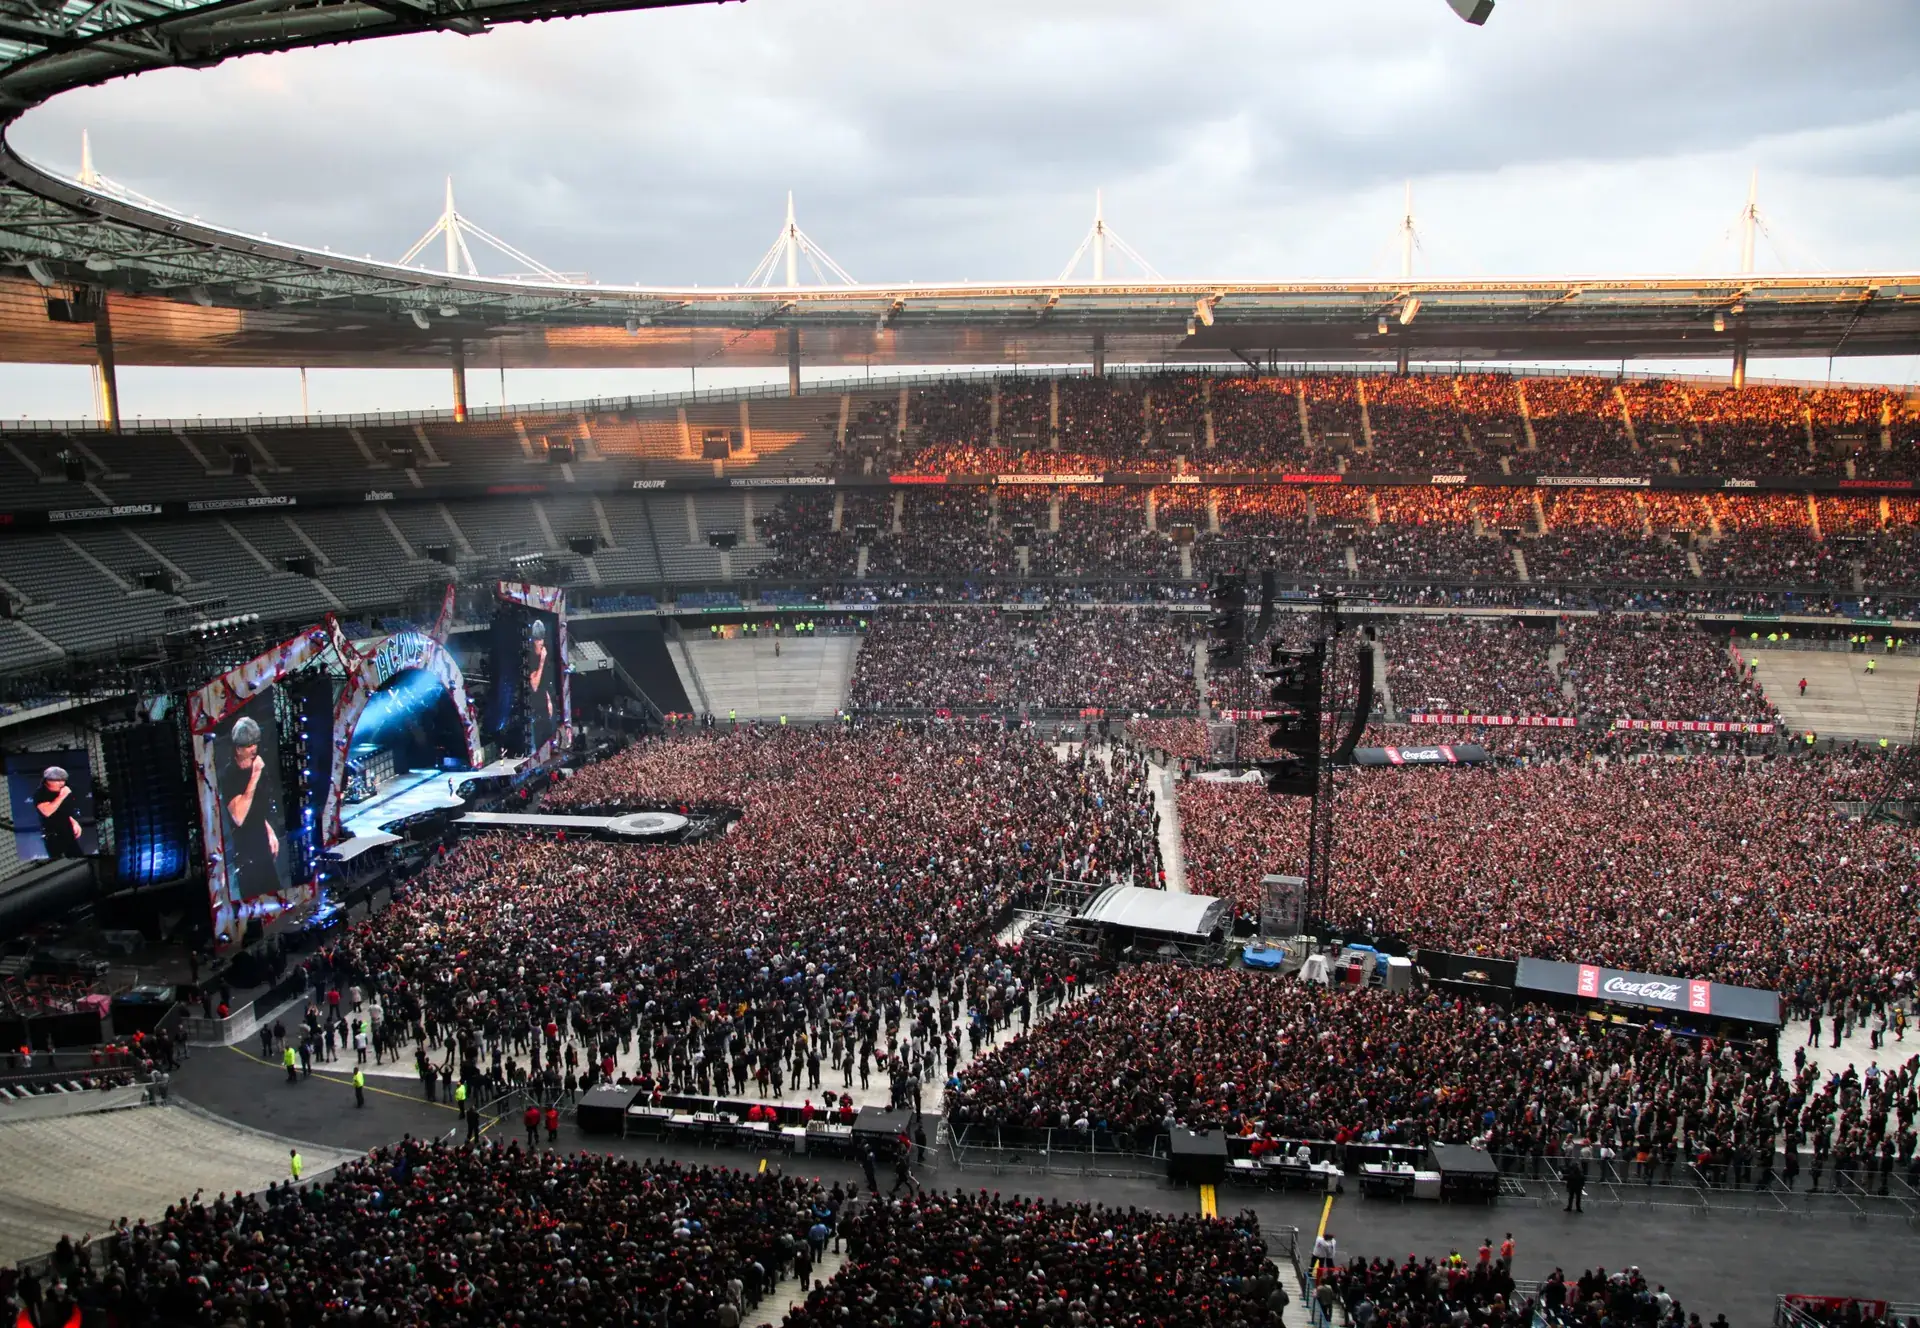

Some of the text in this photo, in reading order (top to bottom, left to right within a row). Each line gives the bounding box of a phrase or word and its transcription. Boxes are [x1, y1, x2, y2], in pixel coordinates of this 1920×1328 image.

[633, 480, 667, 489] L'EQUIPE
[1431, 475, 1468, 484] L'EQUIPE
[1732, 477, 1756, 487] Parisien
[371, 490, 394, 500] Parisien
[1411, 715, 1423, 723] RTL
[1441, 715, 1453, 724] RTL
[1457, 716, 1469, 724] RTL
[1487, 716, 1499, 725] RTL
[1616, 720, 1629, 729] RTL
[1651, 721, 1663, 730] RTL
[1713, 724, 1726, 732] RTL
[1402, 750, 1440, 760] Coca-Cola
[1582, 970, 1595, 992] BAR
[1604, 977, 1682, 1001] Coca-Cola
[1692, 984, 1706, 1007] BAR
